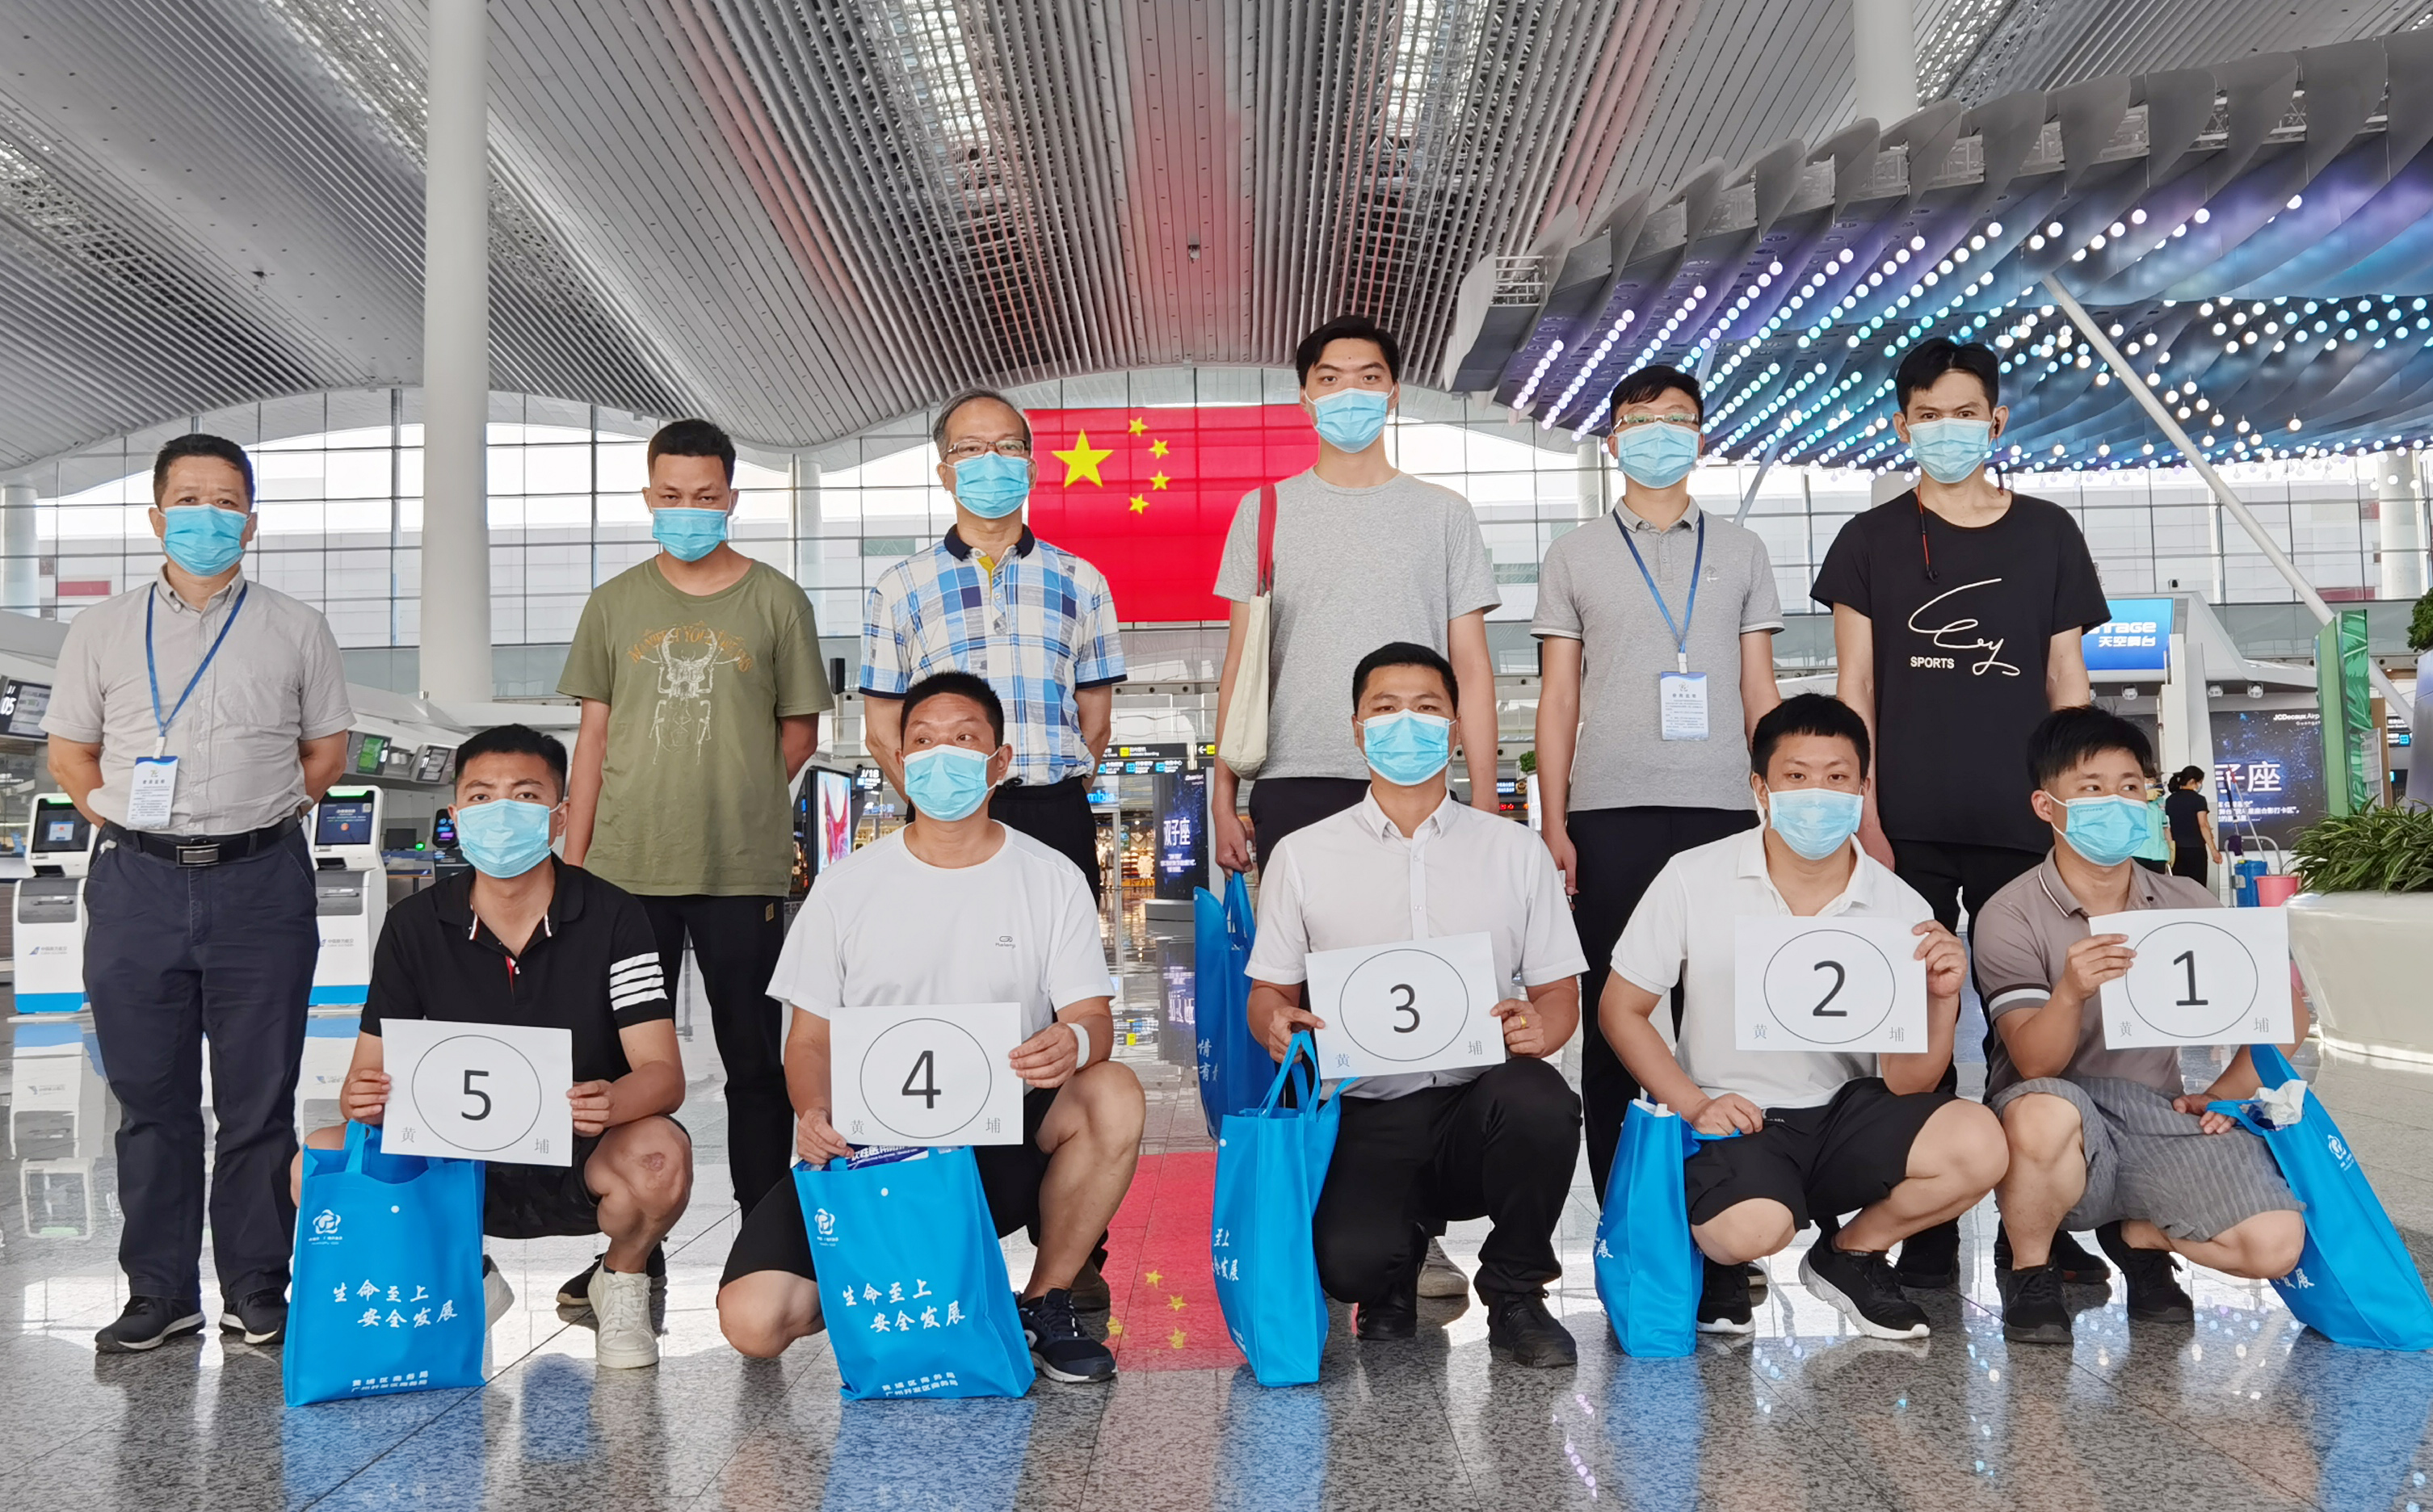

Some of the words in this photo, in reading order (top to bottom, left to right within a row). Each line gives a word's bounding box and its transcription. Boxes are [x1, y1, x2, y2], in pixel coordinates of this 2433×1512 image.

[1910, 656, 1955, 670] SPORTS
[1813, 960, 1847, 1017] 2
[2173, 950, 2208, 1006] 1
[1390, 983, 1420, 1033] 3
[1752, 1023, 1768, 1040] 黄
[1889, 1026, 1905, 1042] 埔
[2119, 1020, 2133, 1037] 黄
[2254, 1017, 2269, 1033] 埔
[1334, 1052, 1351, 1069] 黄
[1467, 1040, 1483, 1056] 埔
[901, 1050, 942, 1109] 4
[461, 1069, 492, 1121] 5
[401, 1127, 416, 1143] 黄
[534, 1138, 549, 1154] 埔
[850, 1119, 864, 1136] 黄
[985, 1117, 1001, 1134] 埔
[333, 1279, 429, 1303] 生命至上
[843, 1279, 932, 1307] 生命至上
[357, 1300, 458, 1328] 安全发展
[870, 1300, 966, 1333] 安全发展
